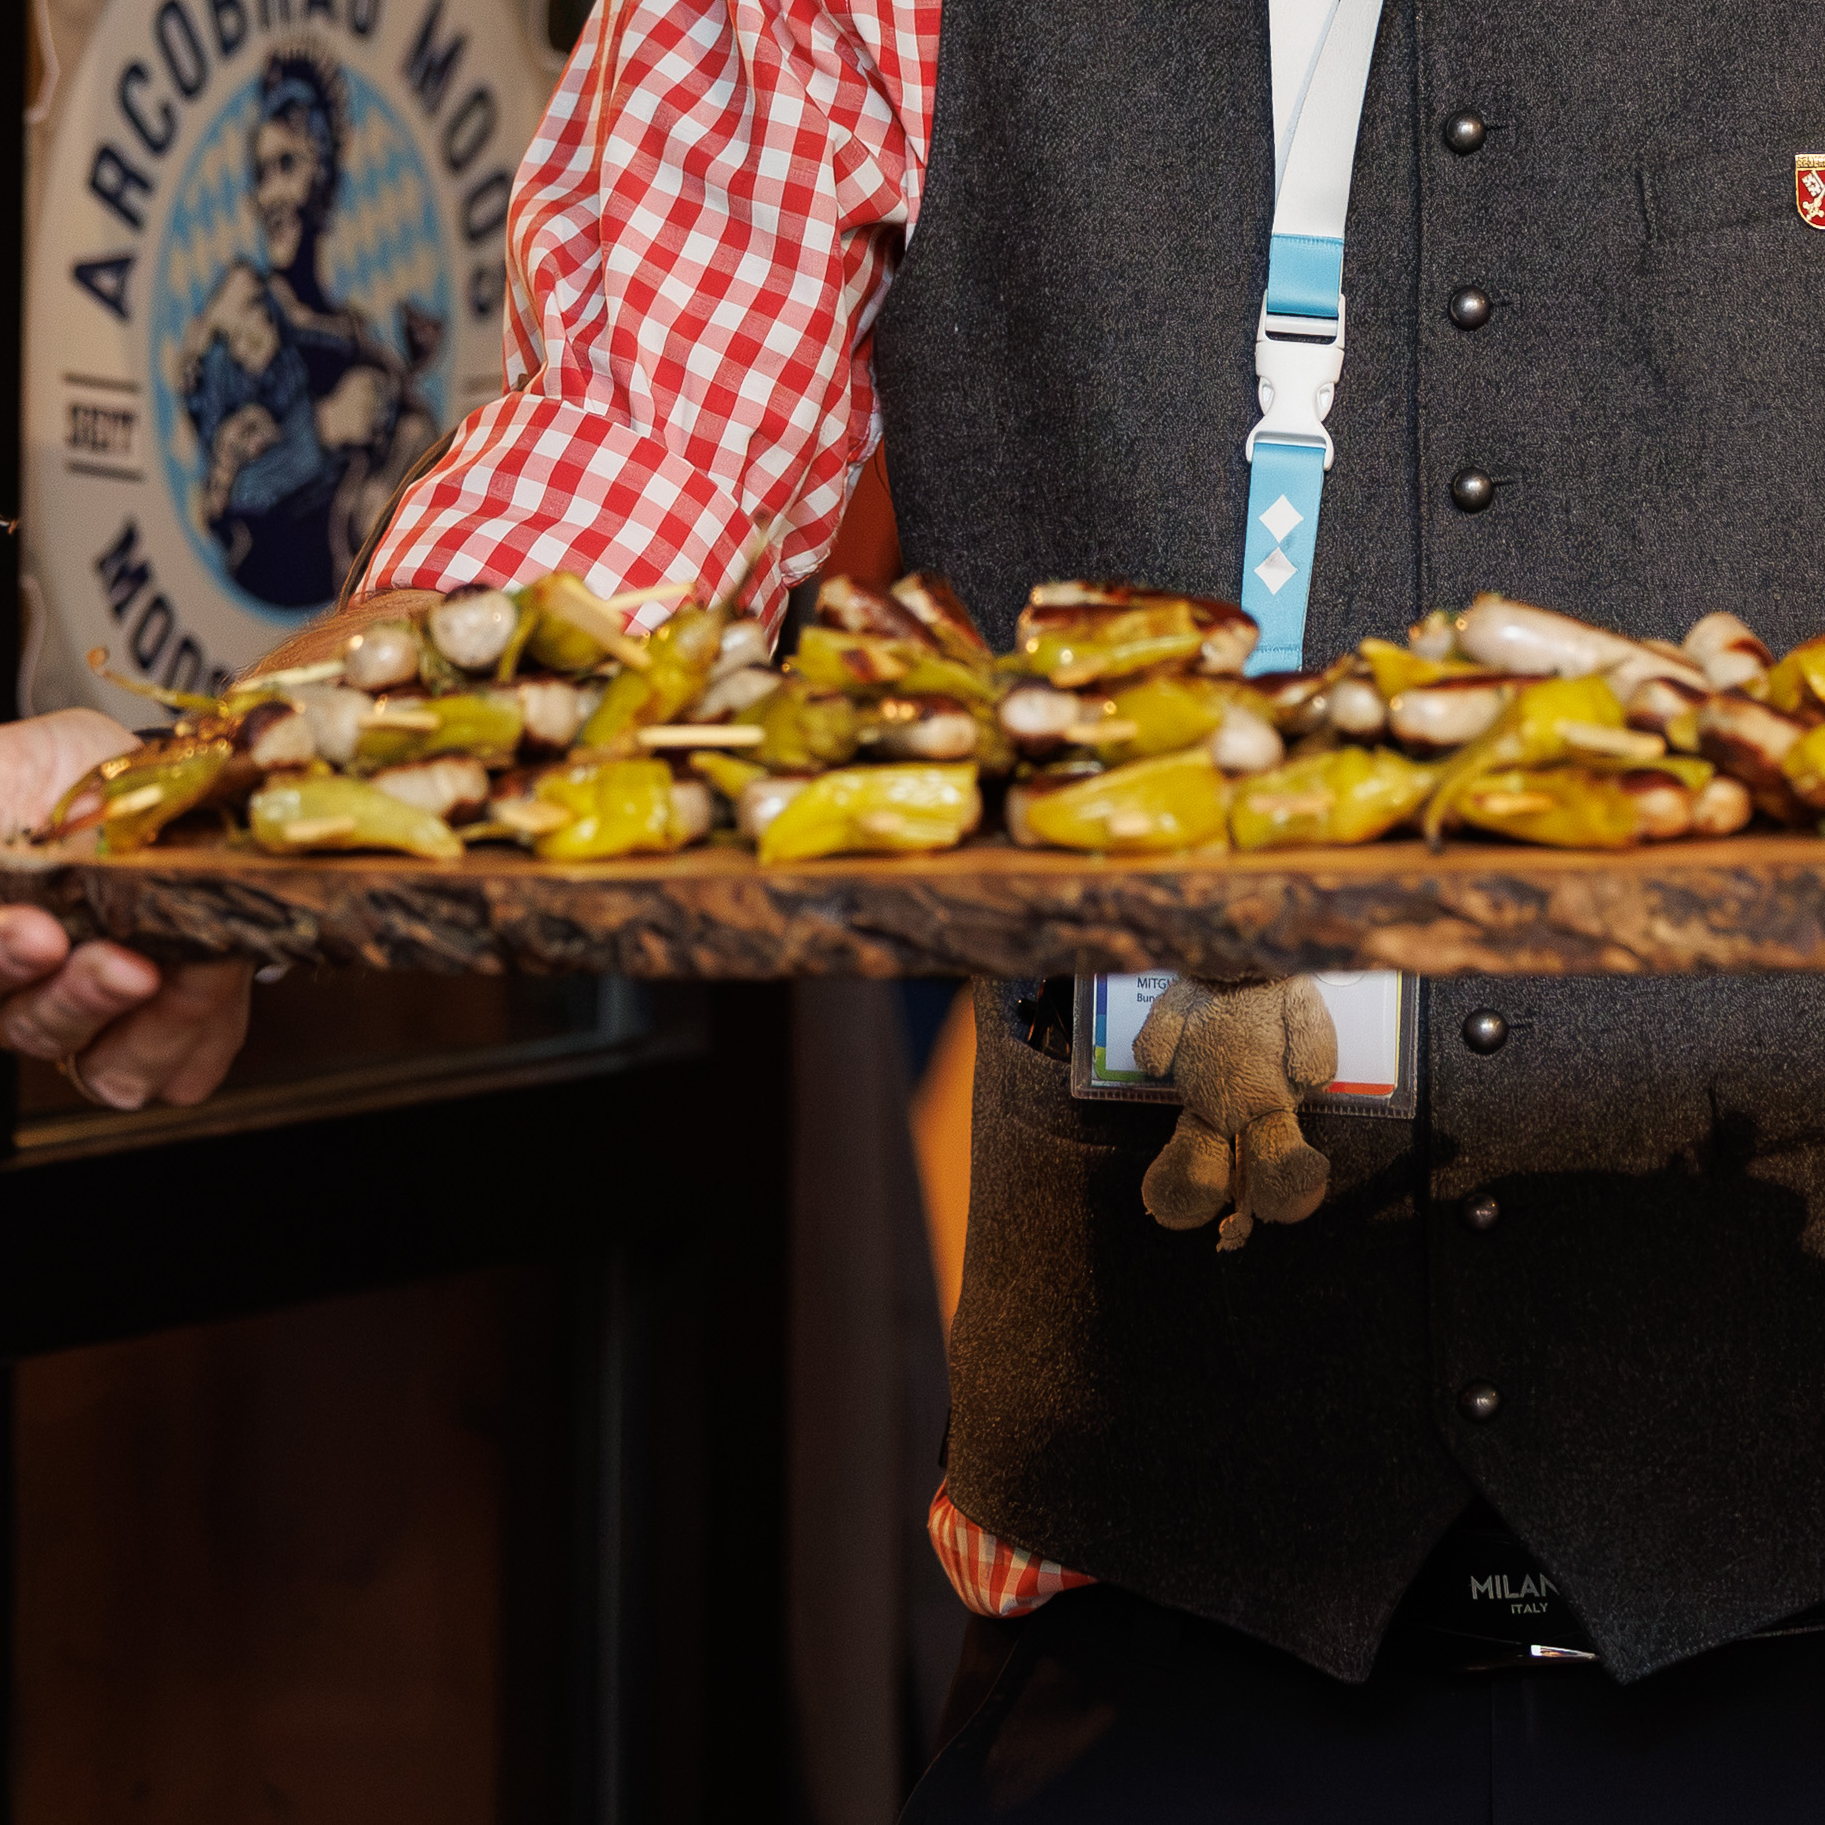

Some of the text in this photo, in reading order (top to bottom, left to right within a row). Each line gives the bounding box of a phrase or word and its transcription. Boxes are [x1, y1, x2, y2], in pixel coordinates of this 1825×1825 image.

[94, 516, 232, 716] MOO
[1136, 976, 1171, 990] MITG
[1136, 993, 1158, 1003] Bun
[1511, 1602, 1548, 1614] ITALY
